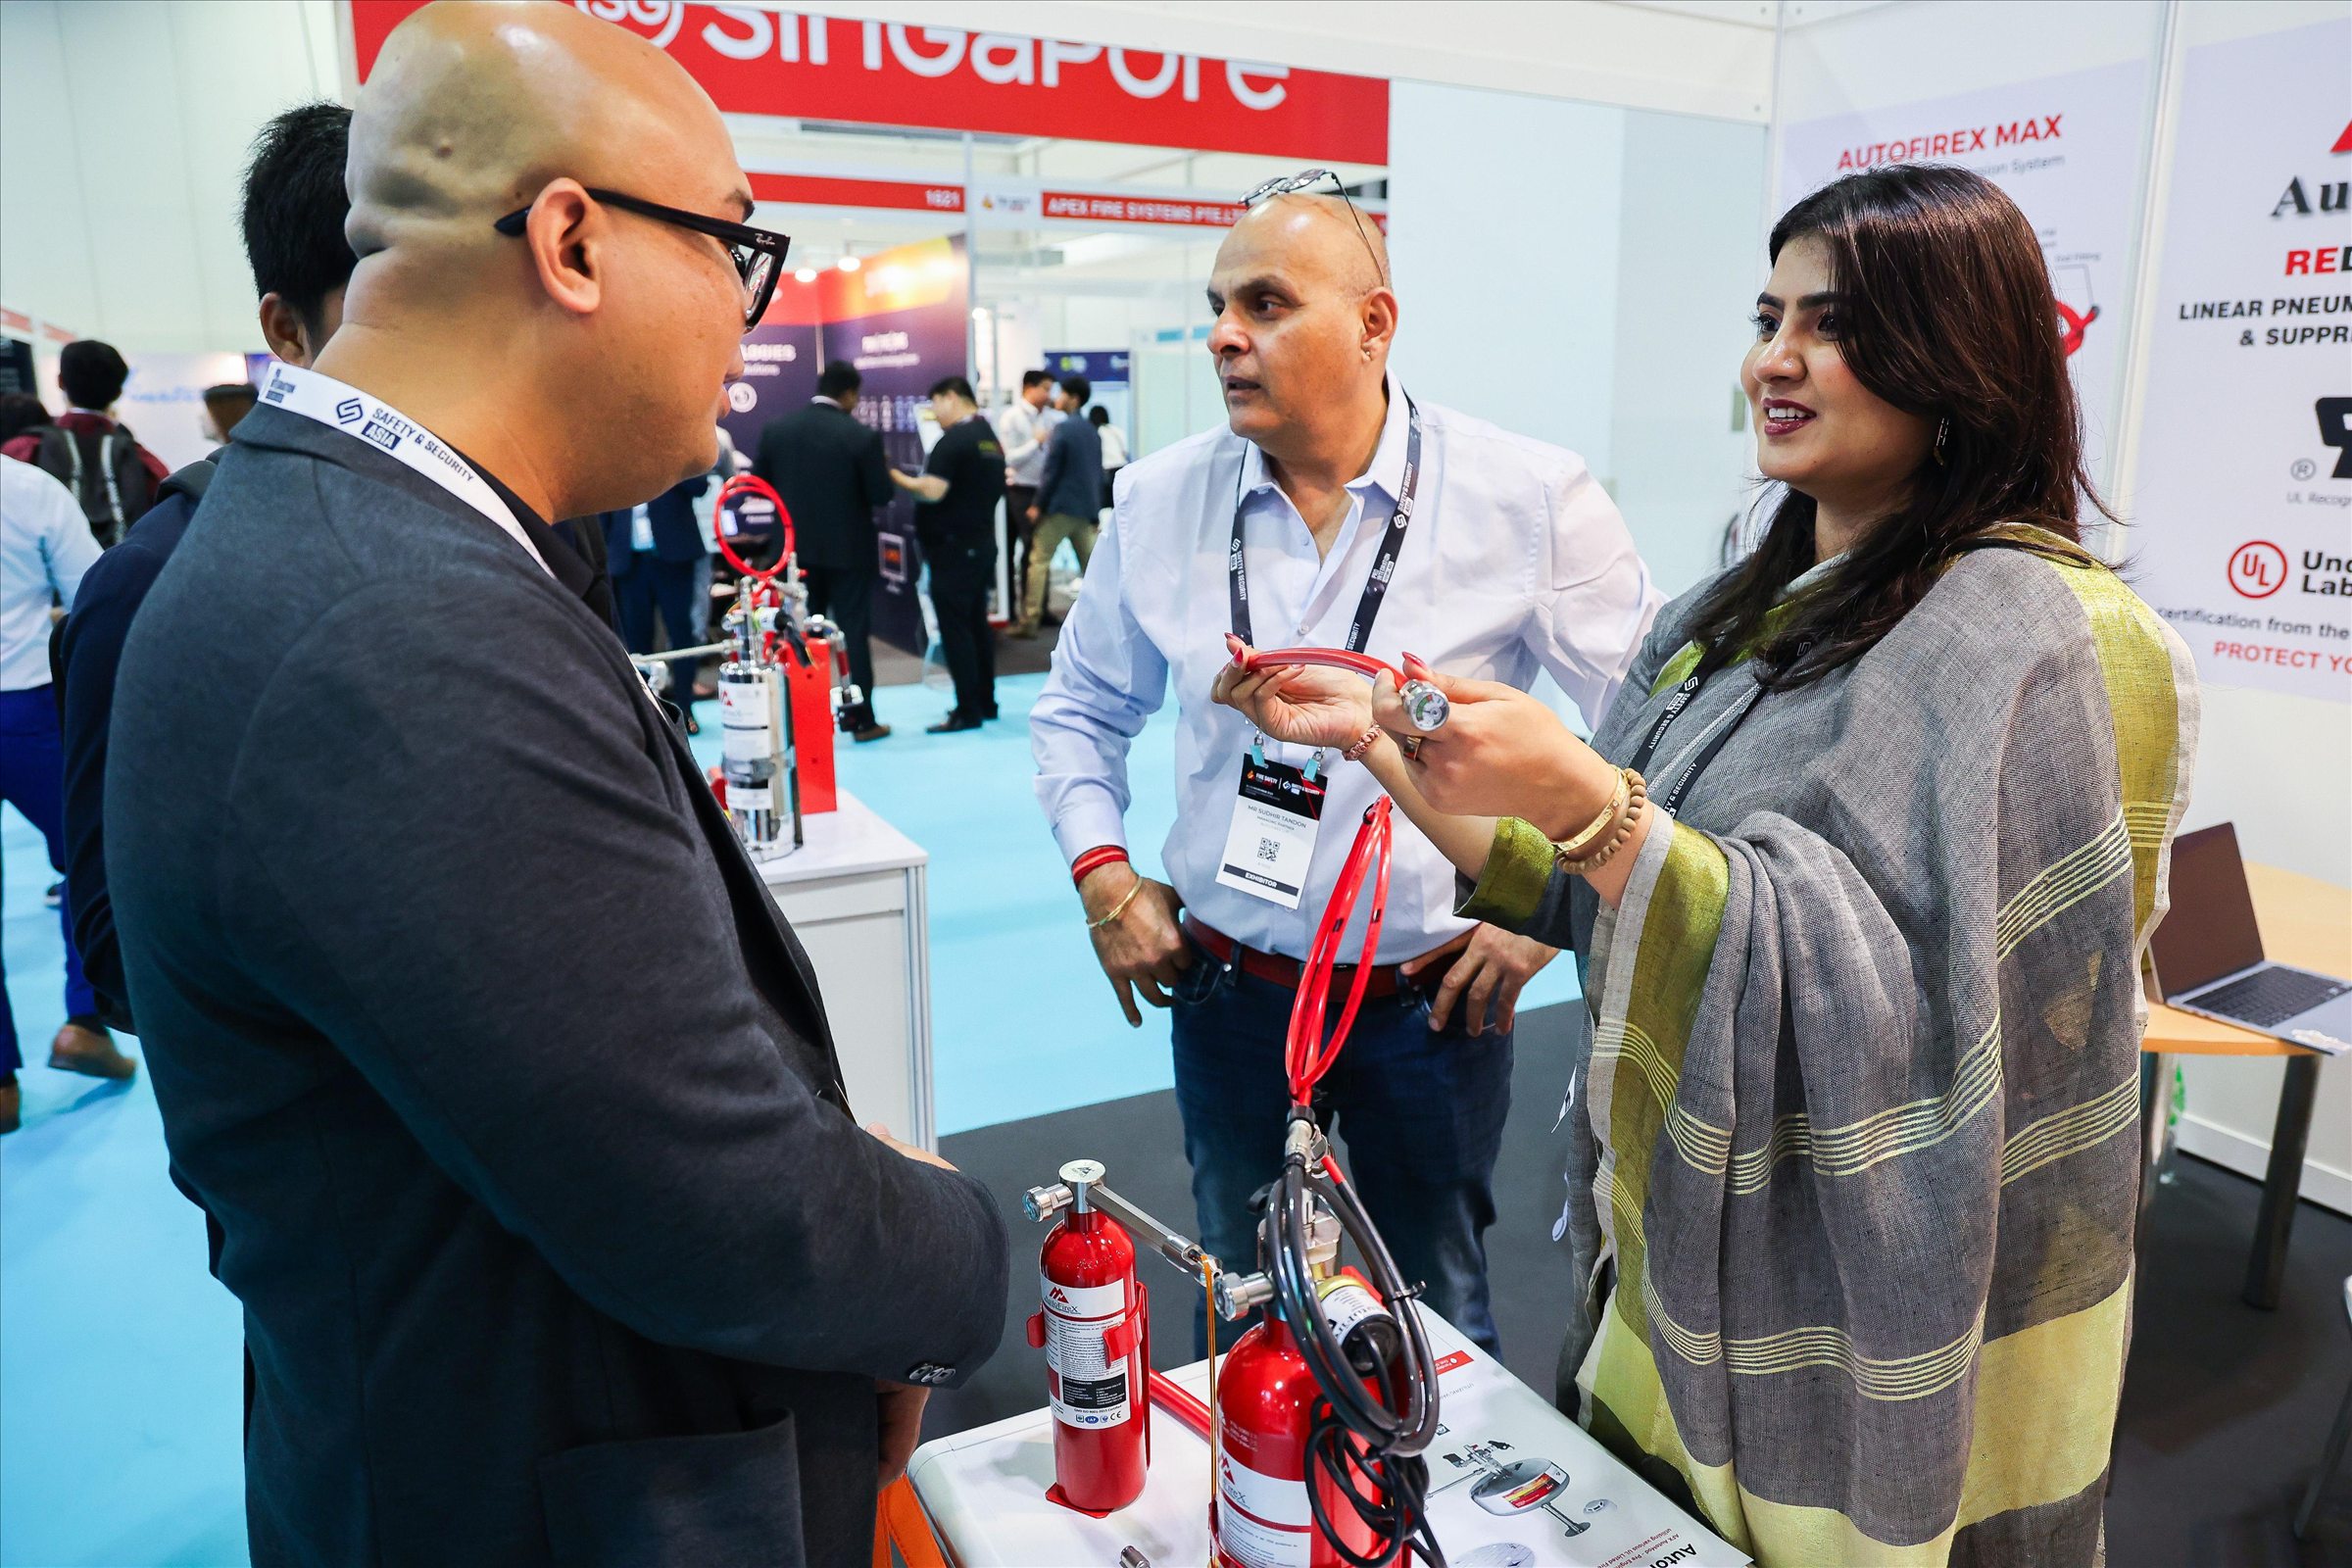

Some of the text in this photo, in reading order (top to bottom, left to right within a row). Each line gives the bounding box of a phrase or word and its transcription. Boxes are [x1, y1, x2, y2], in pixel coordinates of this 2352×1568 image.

[1837, 114, 2063, 171] AUTOFIREX MAX
[1048, 198, 1088, 216] APEX
[1090, 200, 1124, 218] FIRE
[1127, 202, 1193, 221] SYSTEMS
[2179, 300, 2264, 320] LINEAR
[2239, 325, 2351, 346] & SUPPR
[365, 423, 396, 451] ASIA
[372, 408, 475, 482] SAFETY & SECURITY
[2242, 553, 2271, 586] UL
[1238, 574, 1248, 601] SECURITY
[2302, 574, 2351, 597] Lab
[1347, 622, 1360, 650] SECURITY
[2267, 616, 2312, 637] from
[2319, 621, 2350, 640] the
[2213, 641, 2321, 668] PROTECT
[1673, 693, 1690, 714] SAFETY
[1648, 719, 1671, 750] SECURITY
[1673, 762, 1697, 795] SECURITY
[1258, 808, 1281, 820] SUDHIR
[1281, 815, 1307, 829] TANDON
[1245, 871, 1278, 889] EXHIBITOR
[1632, 1540, 1651, 1551] various
[1644, 1540, 1669, 1555] AutoMod
[1608, 1552, 1627, 1565] Listed
